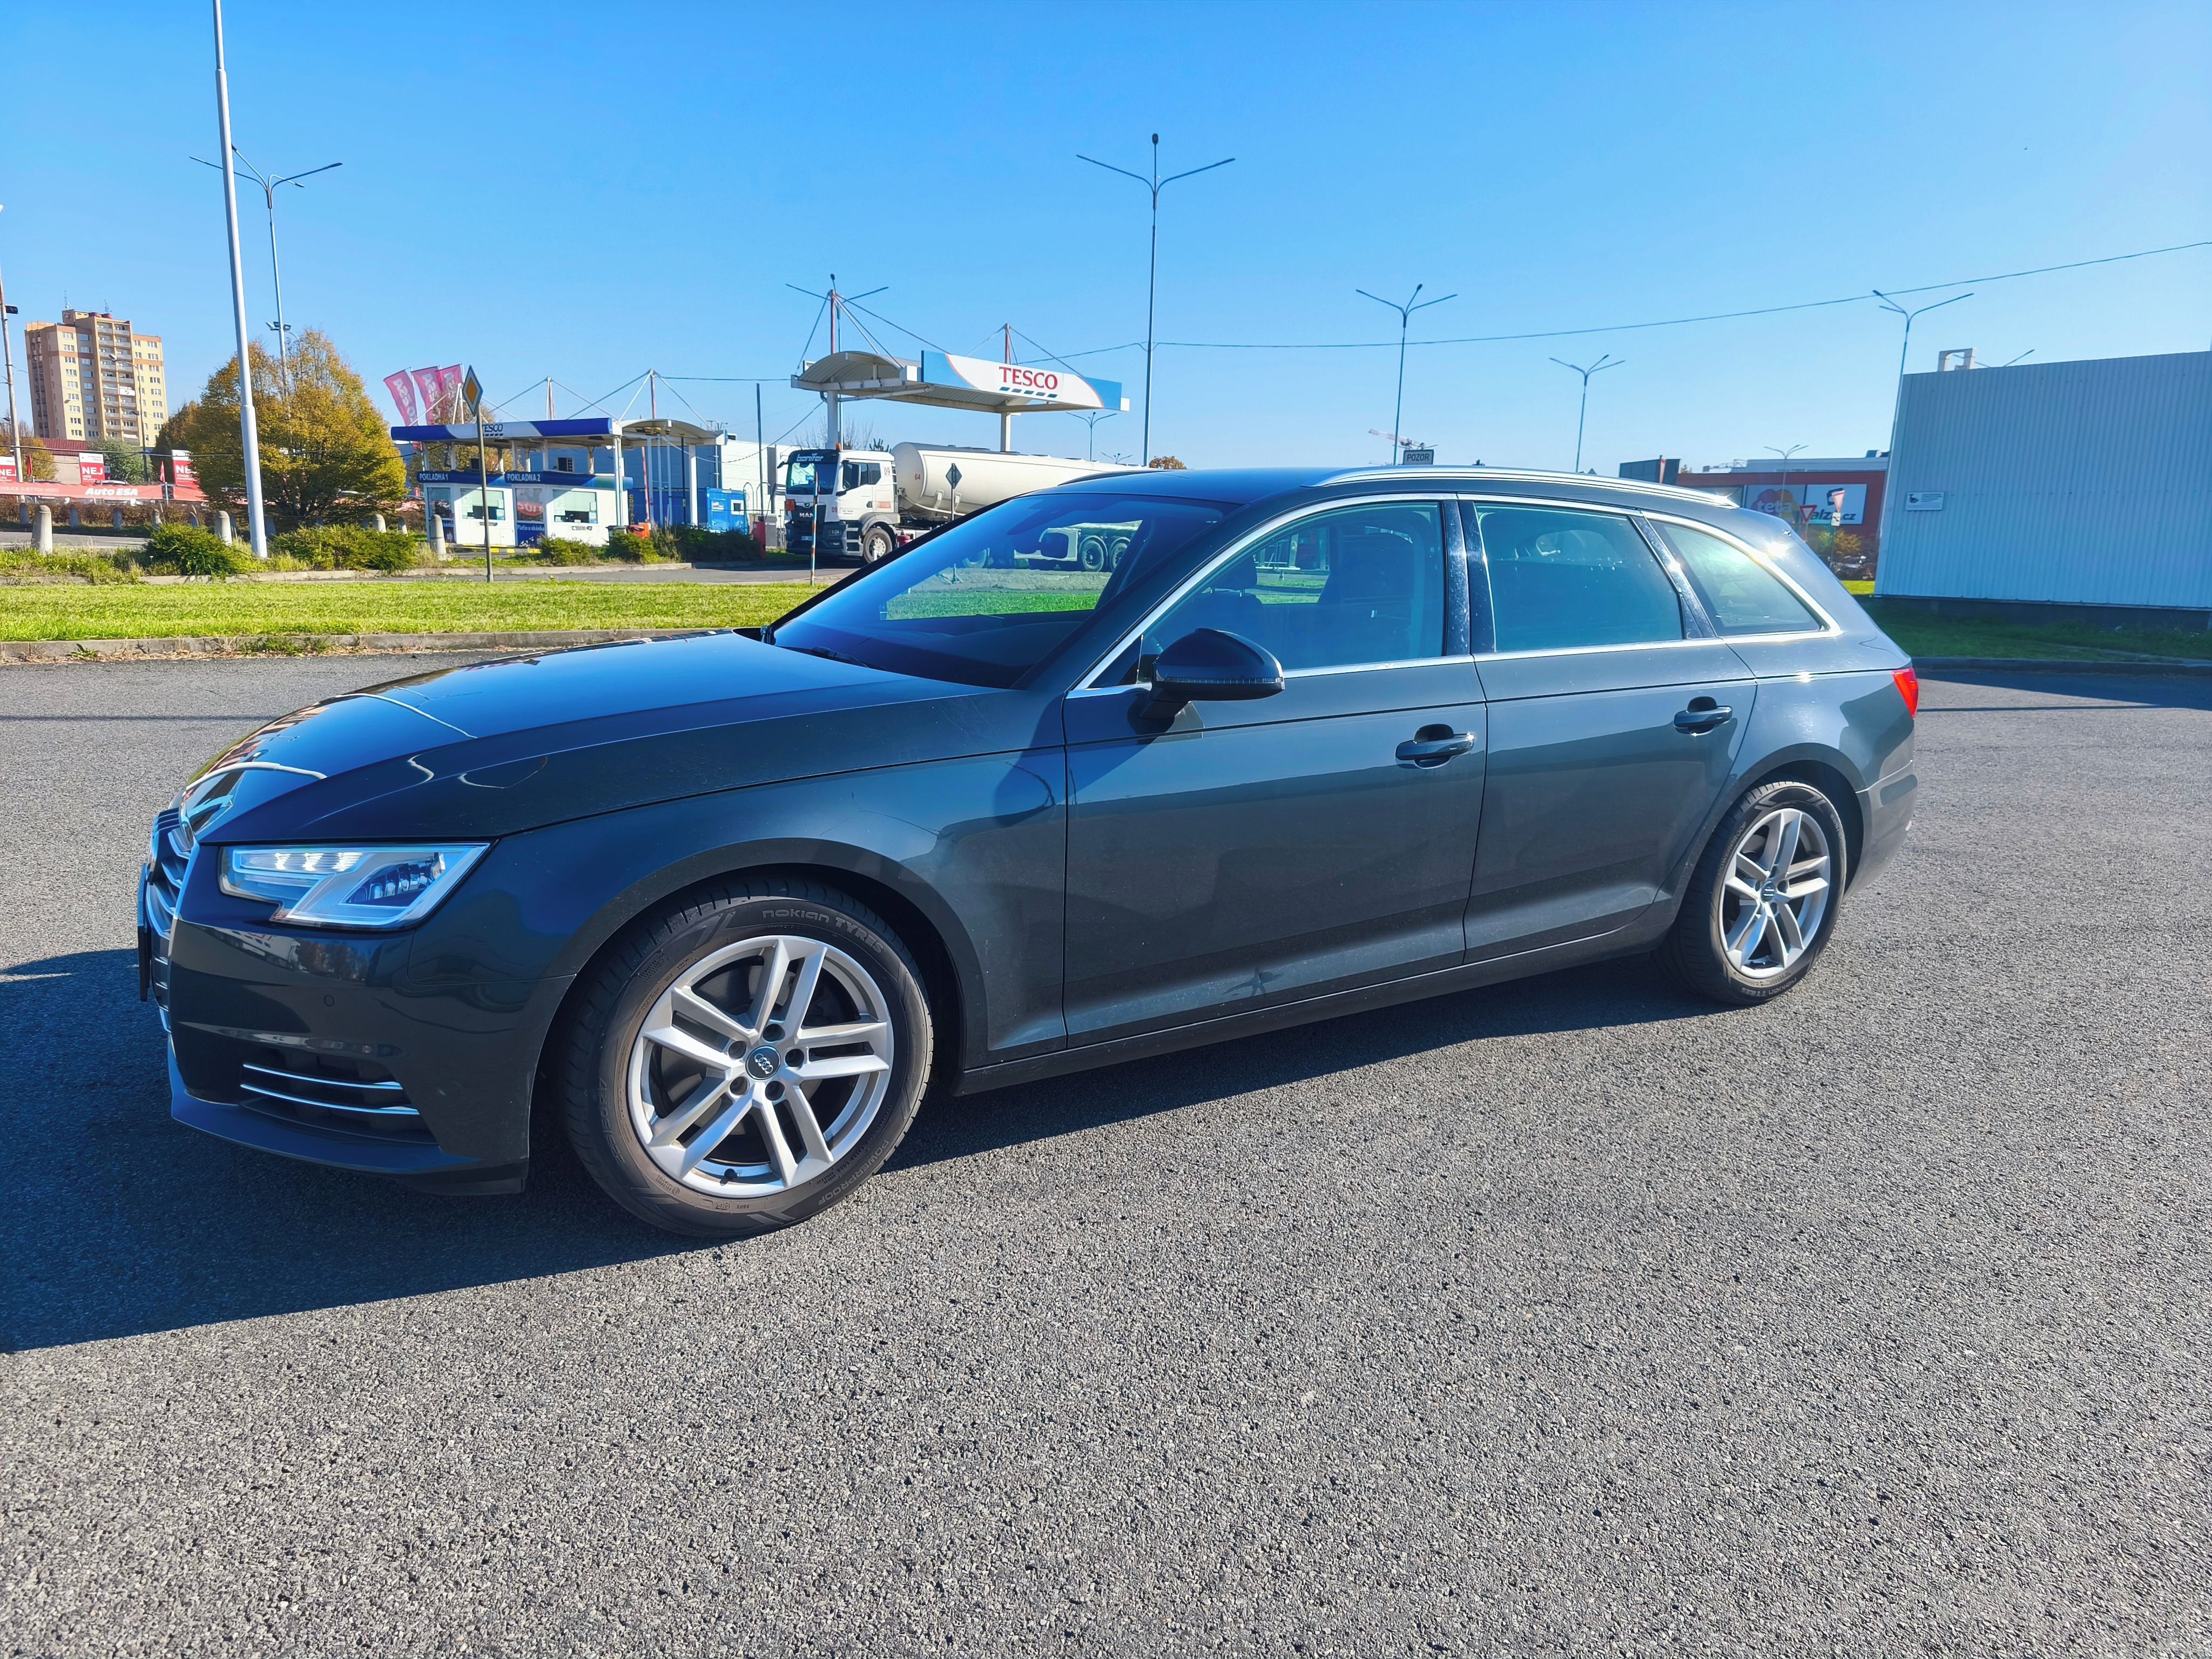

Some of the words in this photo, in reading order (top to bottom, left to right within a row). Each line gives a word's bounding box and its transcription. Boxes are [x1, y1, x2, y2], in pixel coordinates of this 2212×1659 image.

[999, 366, 1057, 390] TESCO
[1407, 453, 1429, 461] POZOR
[82, 466, 103, 475] NEJ
[507, 473, 537, 481] POKLADNA
[85, 488, 113, 496] Auto
[1757, 500, 1792, 513] teta
[835, 916, 885, 954] TYRES
[818, 1139, 889, 1205] POWERPROOF
